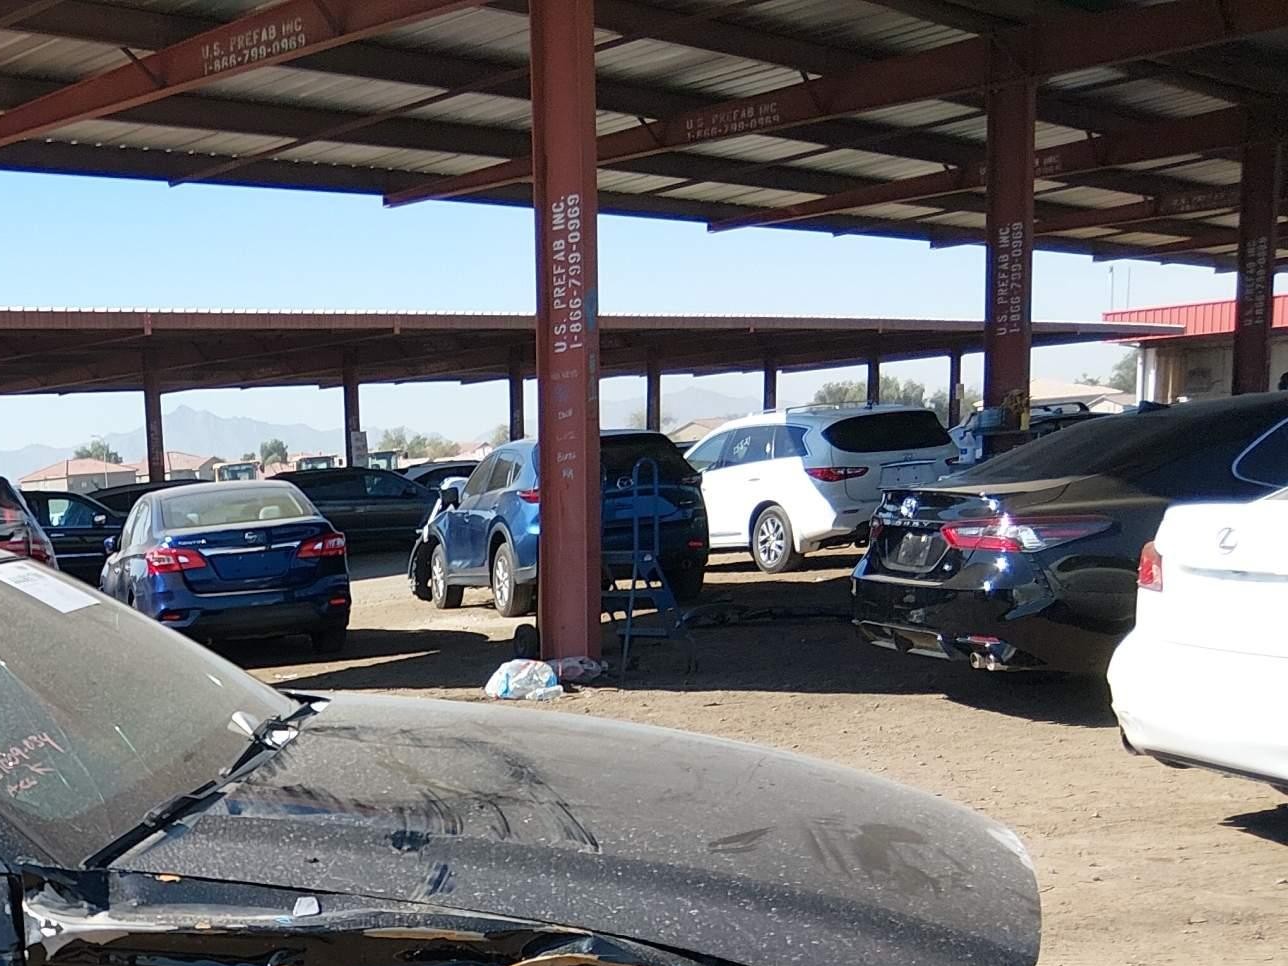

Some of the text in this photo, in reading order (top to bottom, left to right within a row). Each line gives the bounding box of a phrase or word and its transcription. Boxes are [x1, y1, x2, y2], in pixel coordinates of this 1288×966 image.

[230, 25, 277, 51] PREFAB
[552, 195, 568, 353] U.S. PREFAB INC.
[567, 193, 583, 349] 1-866-799-0969
[997, 254, 1010, 305] PREFAB
